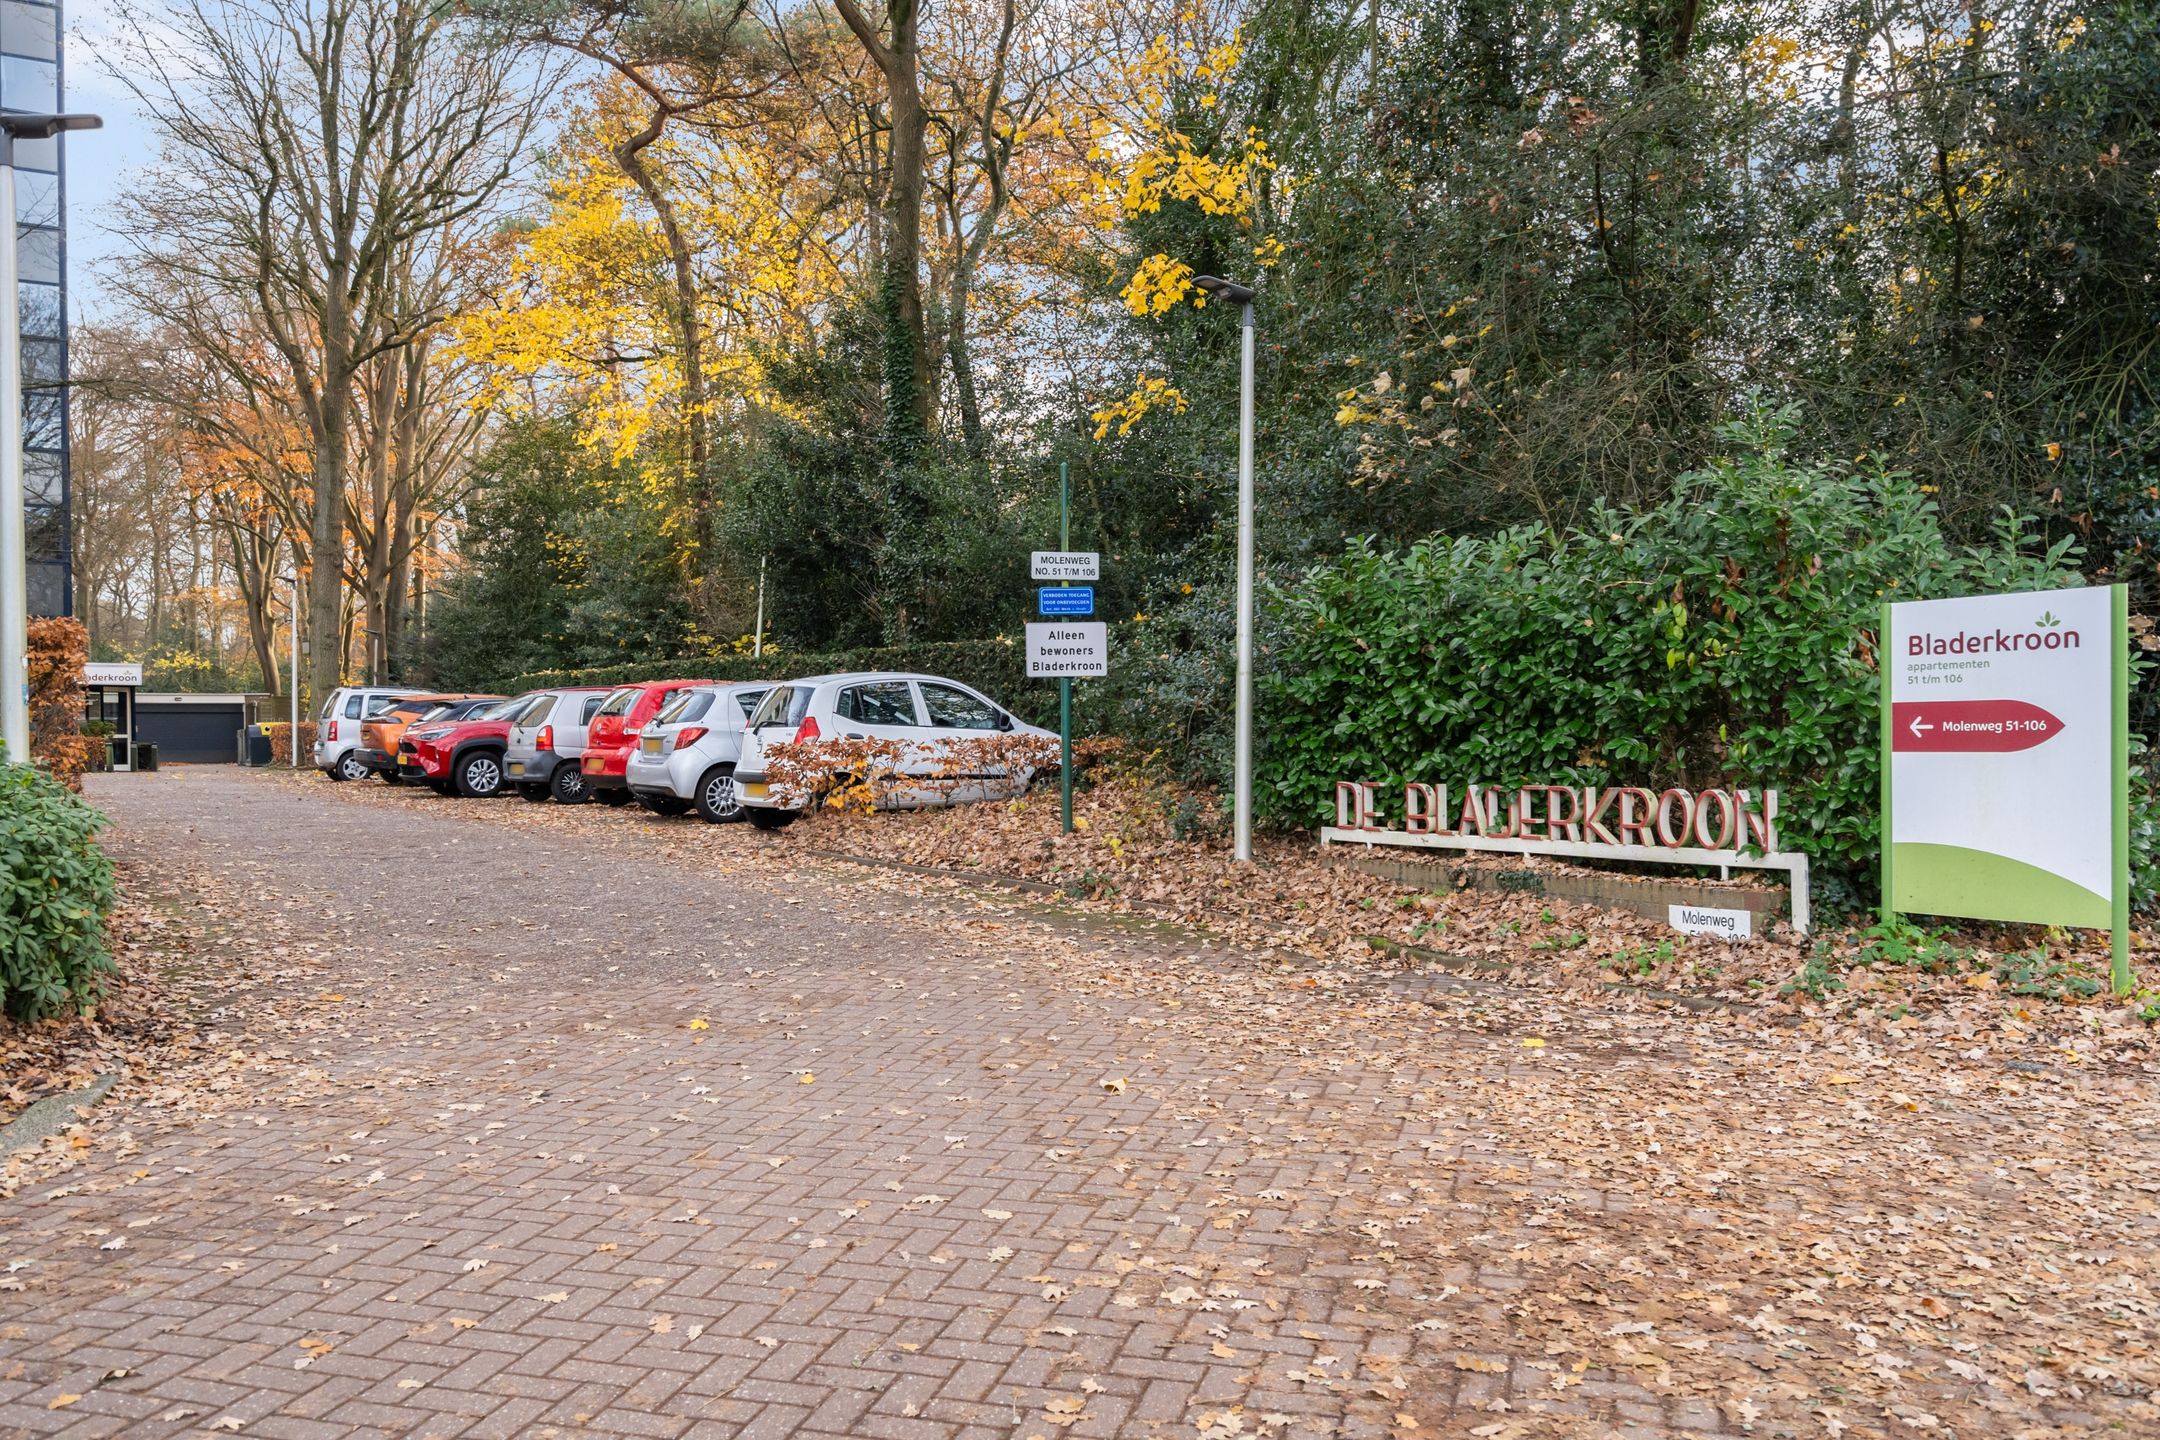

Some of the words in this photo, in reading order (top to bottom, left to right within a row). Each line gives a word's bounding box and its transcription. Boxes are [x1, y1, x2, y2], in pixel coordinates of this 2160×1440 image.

[1040, 556, 1091, 565] MOLENWEG
[1035, 567, 1050, 576] NO.
[1052, 567, 1061, 576] 51
[1063, 568, 1080, 577] T/M
[1082, 568, 1096, 577] 106
[1048, 631, 1085, 640] Alleen
[1908, 629, 2080, 657] Bladerkroon
[1040, 646, 1094, 656] bewoners
[1032, 661, 1102, 671] Bladerkroon
[1907, 659, 1990, 673] appartementen
[1907, 675, 1919, 685] 51
[1922, 675, 1941, 684] t/m
[1943, 674, 1963, 684] 106
[1942, 720, 2003, 734] Molenweg
[2005, 720, 2047, 731] 51-106
[1336, 781, 1387, 832] DE
[1405, 783, 1778, 853] BLADERKROON
[1682, 910, 1735, 931] Molenweg
